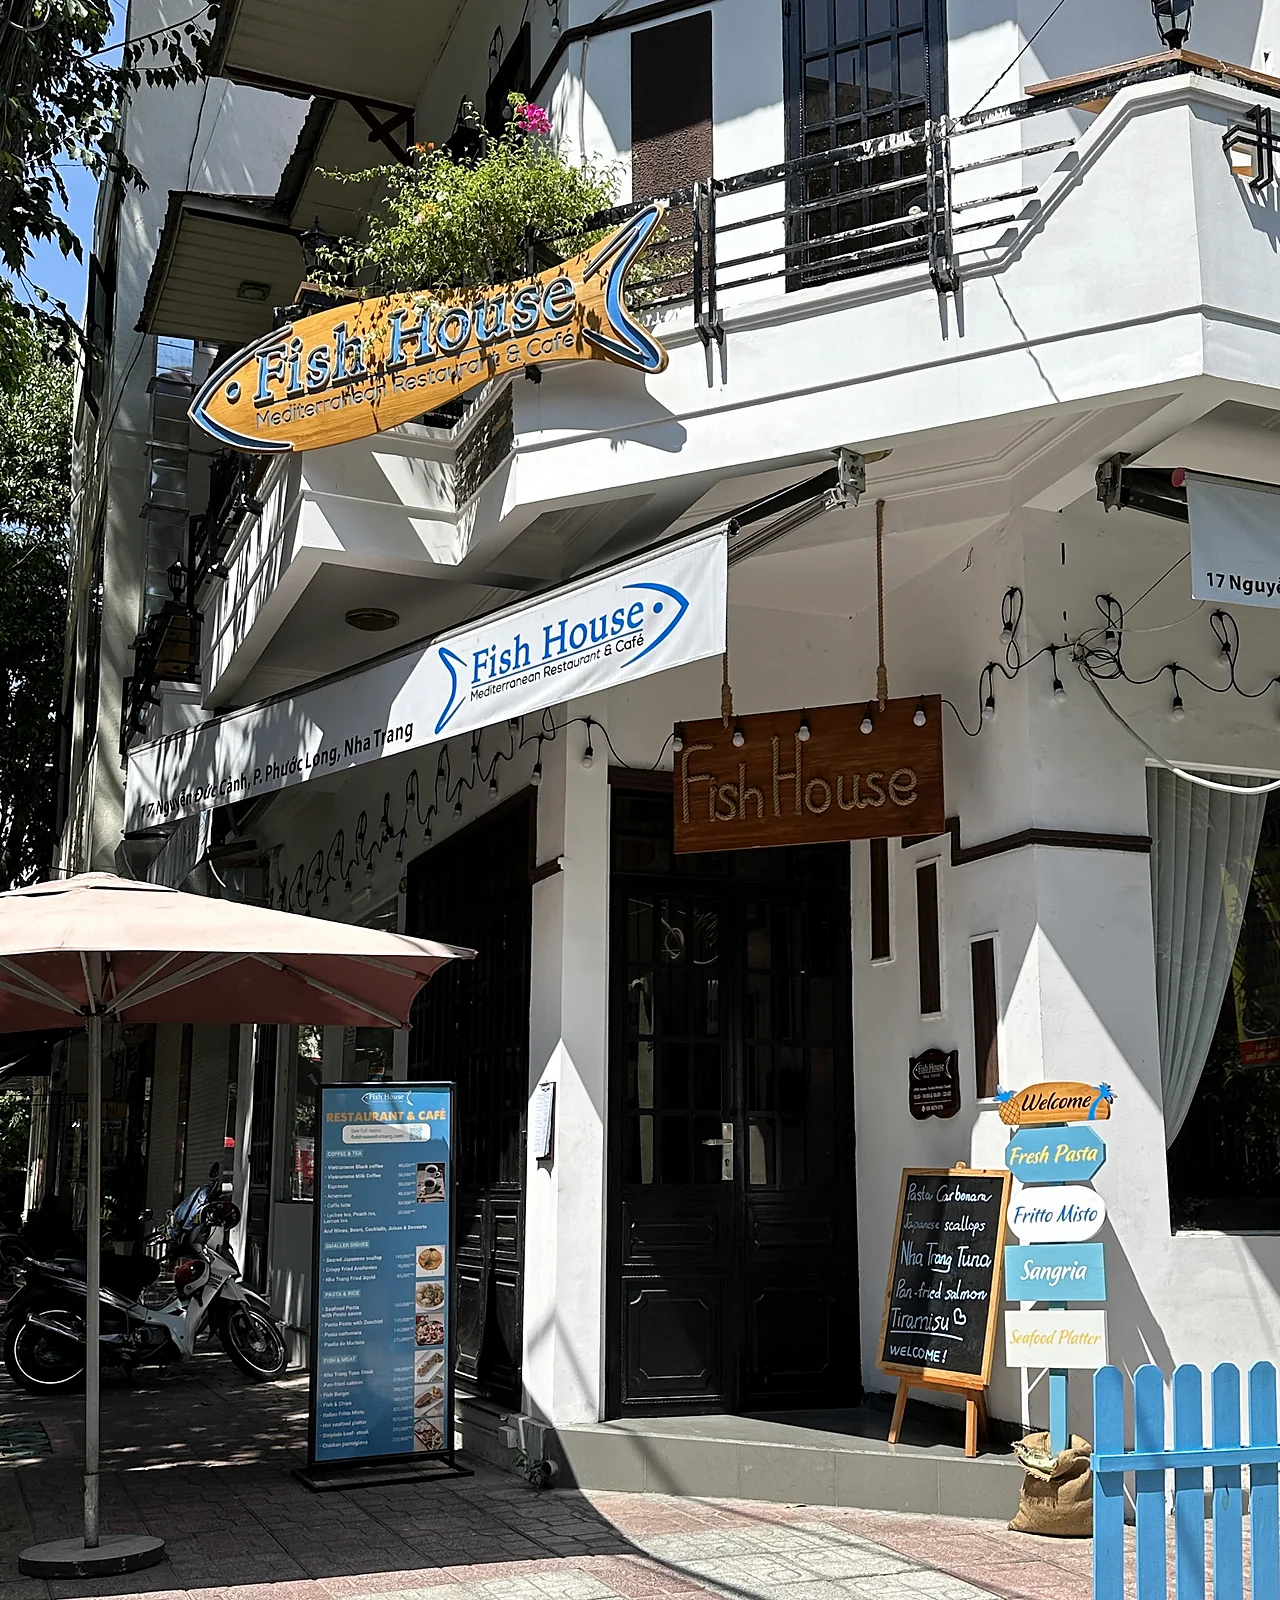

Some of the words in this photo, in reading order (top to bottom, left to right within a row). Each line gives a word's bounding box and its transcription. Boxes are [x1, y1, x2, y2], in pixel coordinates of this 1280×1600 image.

[252, 322, 367, 405] Fish
[387, 276, 576, 370] House
[256, 384, 387, 430] Mediterranean
[392, 353, 500, 395] Restaurant
[506, 345, 521, 364] &
[526, 327, 576, 358] Café
[1206, 571, 1225, 588] 17
[471, 633, 531, 684] Fish
[542, 601, 644, 660] House
[470, 670, 541, 702] Mediterranean
[543, 649, 601, 678] Restaurant
[604, 644, 613, 656] &
[615, 632, 644, 652] Café
[220, 773, 250, 795] Cảnh,
[253, 768, 263, 785] P.
[265, 755, 303, 782] Phước
[305, 751, 341, 769] Long,
[345, 733, 371, 756] Nha
[374, 722, 414, 748] Trang
[681, 743, 764, 824] Fish
[770, 733, 919, 816] House
[369, 1093, 383, 1101] Fish
[384, 1093, 404, 1101] House
[1021, 1092, 1092, 1112] Welcome
[326, 1111, 405, 1122] RESTAURANT
[406, 1111, 415, 1121] &
[418, 1108, 446, 1120] CAFÉ
[1010, 1145, 1049, 1166] Fresh
[1054, 1144, 1098, 1164] Pasta
[907, 1182, 933, 1202] Pasta
[936, 1184, 992, 1202] Carbonara
[903, 1213, 940, 1233] Japanese
[944, 1215, 986, 1237] scallops
[1013, 1206, 1053, 1224] Fritto
[1056, 1204, 1098, 1223] Misto
[900, 1240, 923, 1267] Nha
[926, 1242, 952, 1273] Trang
[957, 1245, 992, 1268] Tuna
[1020, 1259, 1088, 1287] Sangria
[895, 1278, 943, 1299] Pan-fried
[944, 1279, 988, 1300] salmon
[891, 1307, 950, 1331] Tiramisu
[1009, 1329, 1057, 1347] Seafood
[1058, 1329, 1101, 1345] Platter
[889, 1345, 948, 1364] WELCOME!
